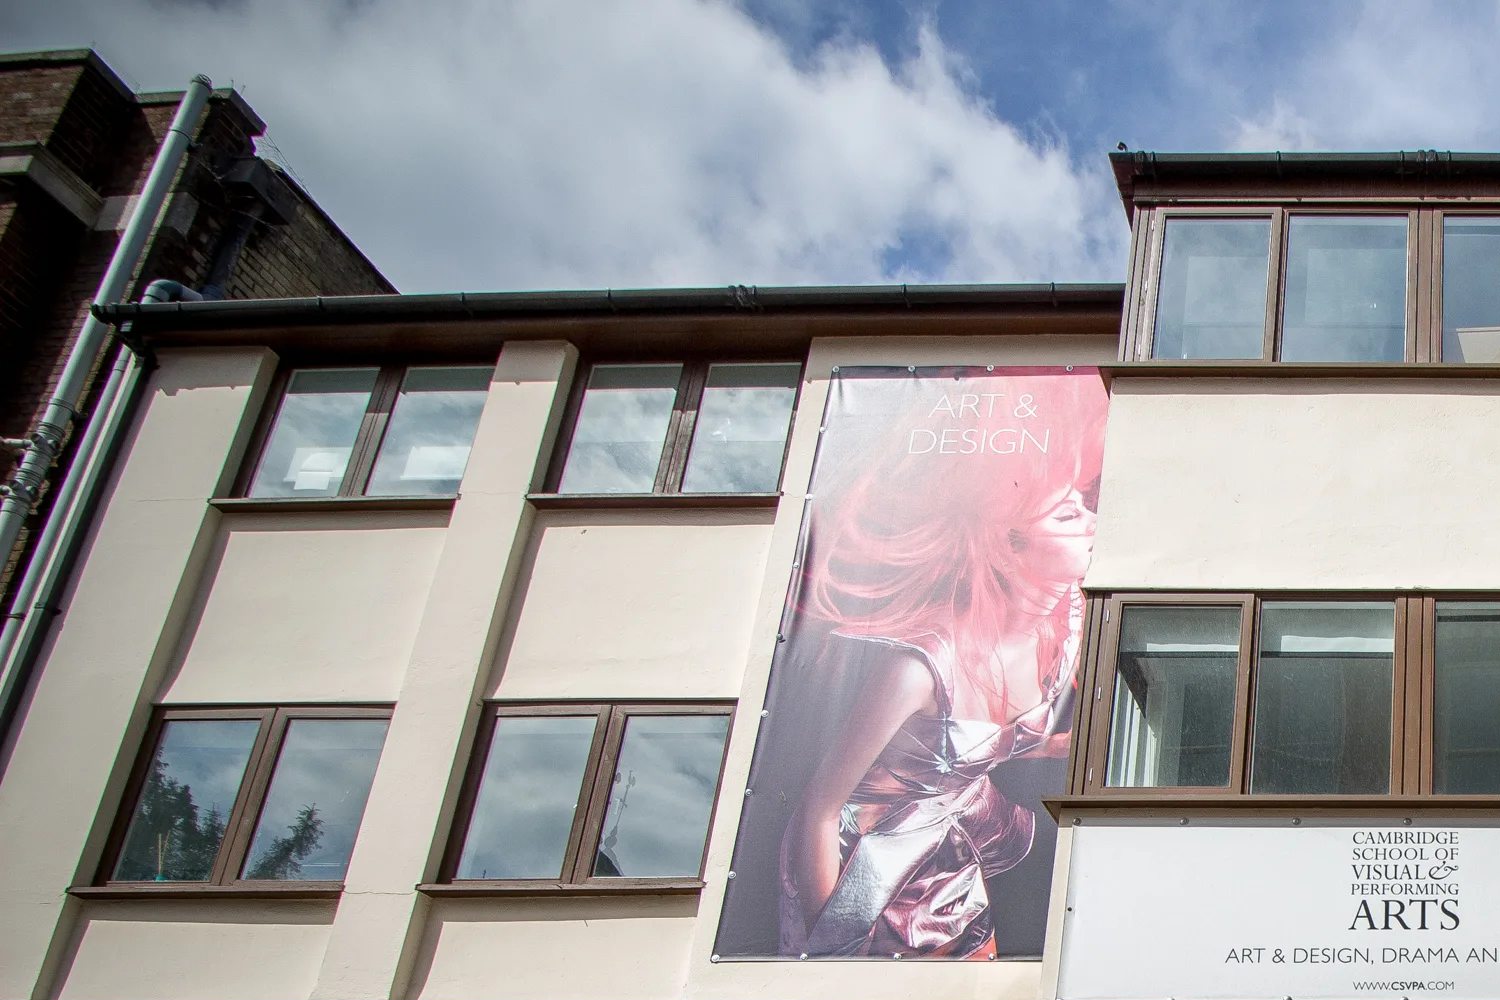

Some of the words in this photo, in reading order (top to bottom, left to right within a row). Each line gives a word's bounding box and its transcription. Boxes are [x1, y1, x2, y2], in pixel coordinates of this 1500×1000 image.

[928, 394, 1006, 418] ART
[1013, 394, 1038, 418] &
[908, 429, 1050, 454] DESIGN
[1352, 831, 1459, 844] CAMBRIDGE
[1352, 848, 1429, 860] SCHOOL
[1434, 848, 1459, 860] OF
[1351, 864, 1426, 880] VISUAL
[1428, 861, 1459, 880] &
[1351, 883, 1459, 895] PERFORMING
[1348, 899, 1460, 930] ARTS
[1225, 948, 1266, 964] ART
[1272, 948, 1285, 964] &
[1293, 948, 1374, 965] DESIGN,
[1382, 947, 1459, 963] DRAMA
[1353, 981, 1454, 991] WWW.CSVPA.COM
